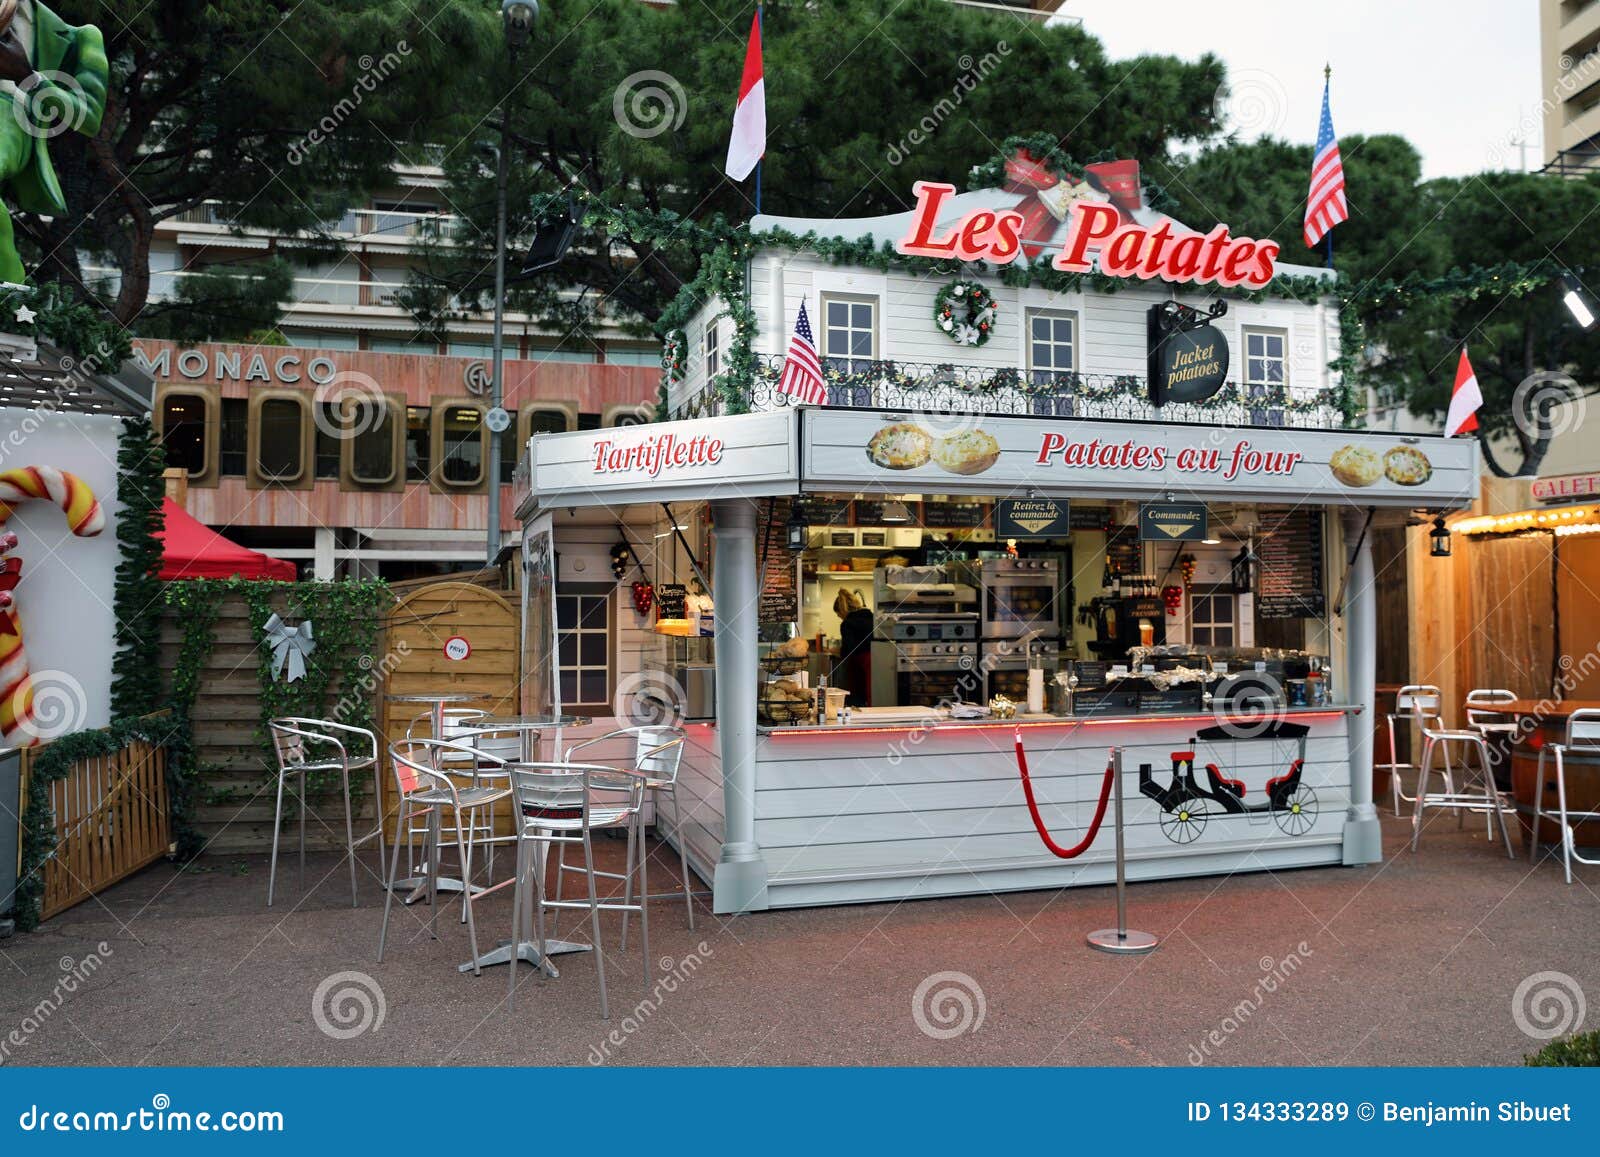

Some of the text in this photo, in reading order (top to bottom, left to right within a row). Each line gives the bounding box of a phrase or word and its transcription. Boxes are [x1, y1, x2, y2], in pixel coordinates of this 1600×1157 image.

[898, 182, 1280, 288] Les Patates
[133, 347, 336, 384] MONACO
[1172, 343, 1215, 370] Jacket
[1167, 361, 1220, 389] potatoes
[592, 433, 723, 476] Tartiflette
[1035, 432, 1301, 479] Patates au four
[1533, 476, 1600, 497] GALET
[1009, 510, 1059, 519] commande
[1013, 501, 1056, 511] Retirez la
[1148, 510, 1201, 520] Commandez
